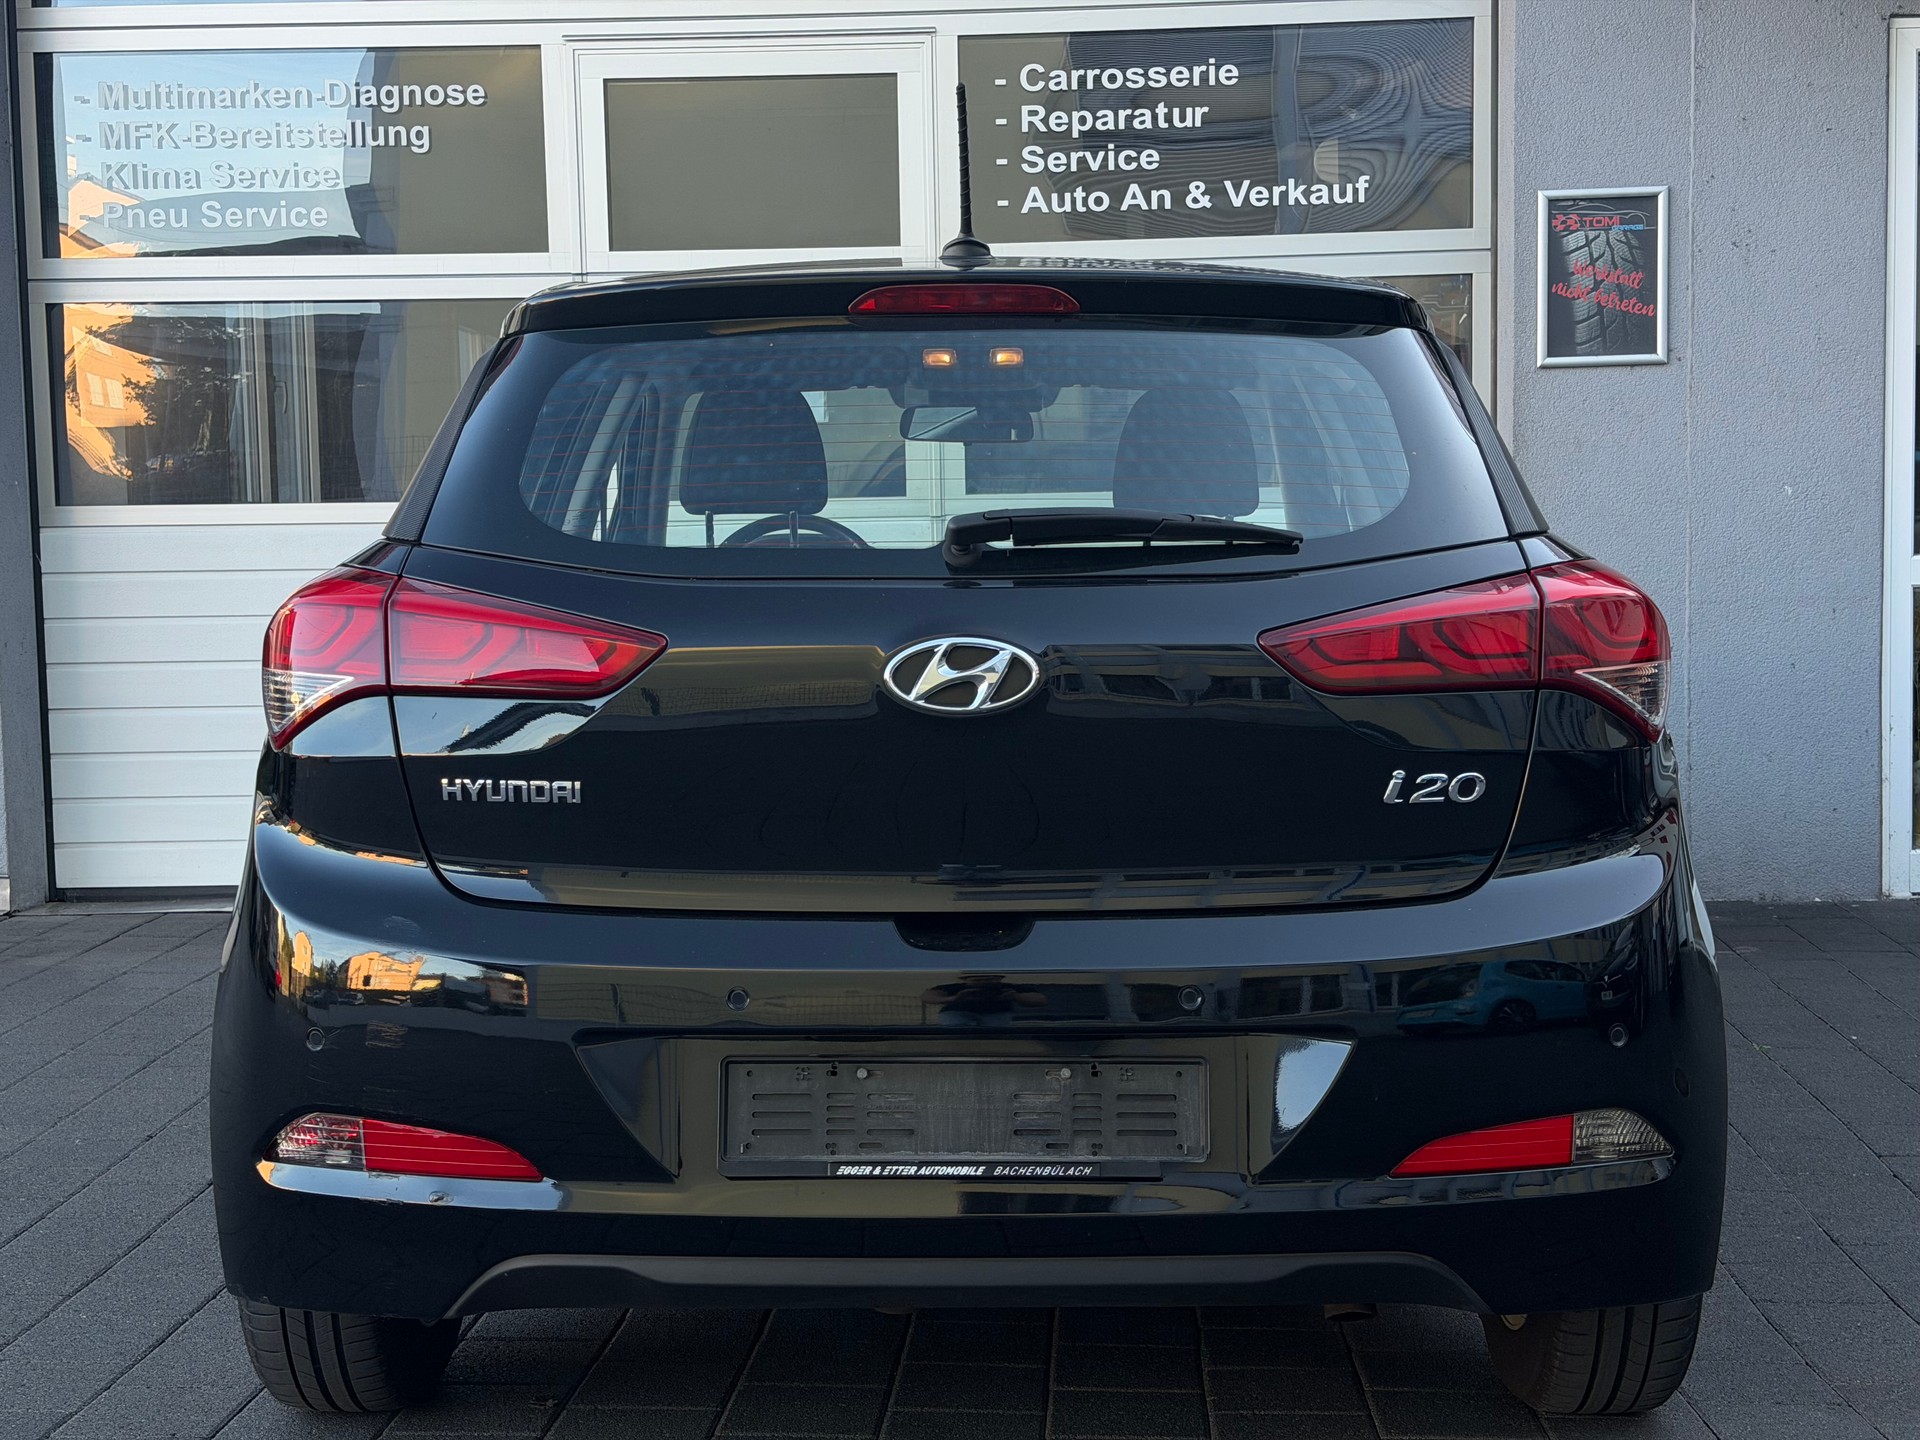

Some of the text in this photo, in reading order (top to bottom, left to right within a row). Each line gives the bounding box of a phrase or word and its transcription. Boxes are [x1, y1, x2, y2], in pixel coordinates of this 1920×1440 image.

[1019, 58, 1239, 92] Carrosserie
[98, 79, 487, 113] Multimarken-Diagnose
[1020, 101, 1209, 138] Reparatur
[99, 119, 431, 153] MFK-Bereitstellung
[101, 159, 341, 189] Klima Service
[1020, 143, 1160, 174] Service
[1020, 186, 1110, 214] Auto
[1120, 183, 1172, 211] An
[1185, 180, 1213, 209] &
[1223, 175, 1371, 208] Verkauf
[103, 201, 189, 229] Pneu
[200, 200, 328, 228] Service
[1573, 259, 1645, 289] Werkstatt
[1551, 281, 1656, 317] nicht betreten
[440, 778, 582, 804] HYUNDAI
[836, 1164, 1093, 1176] EGGER & ETTER AUTOMOBILE BACHENBÜLACH
